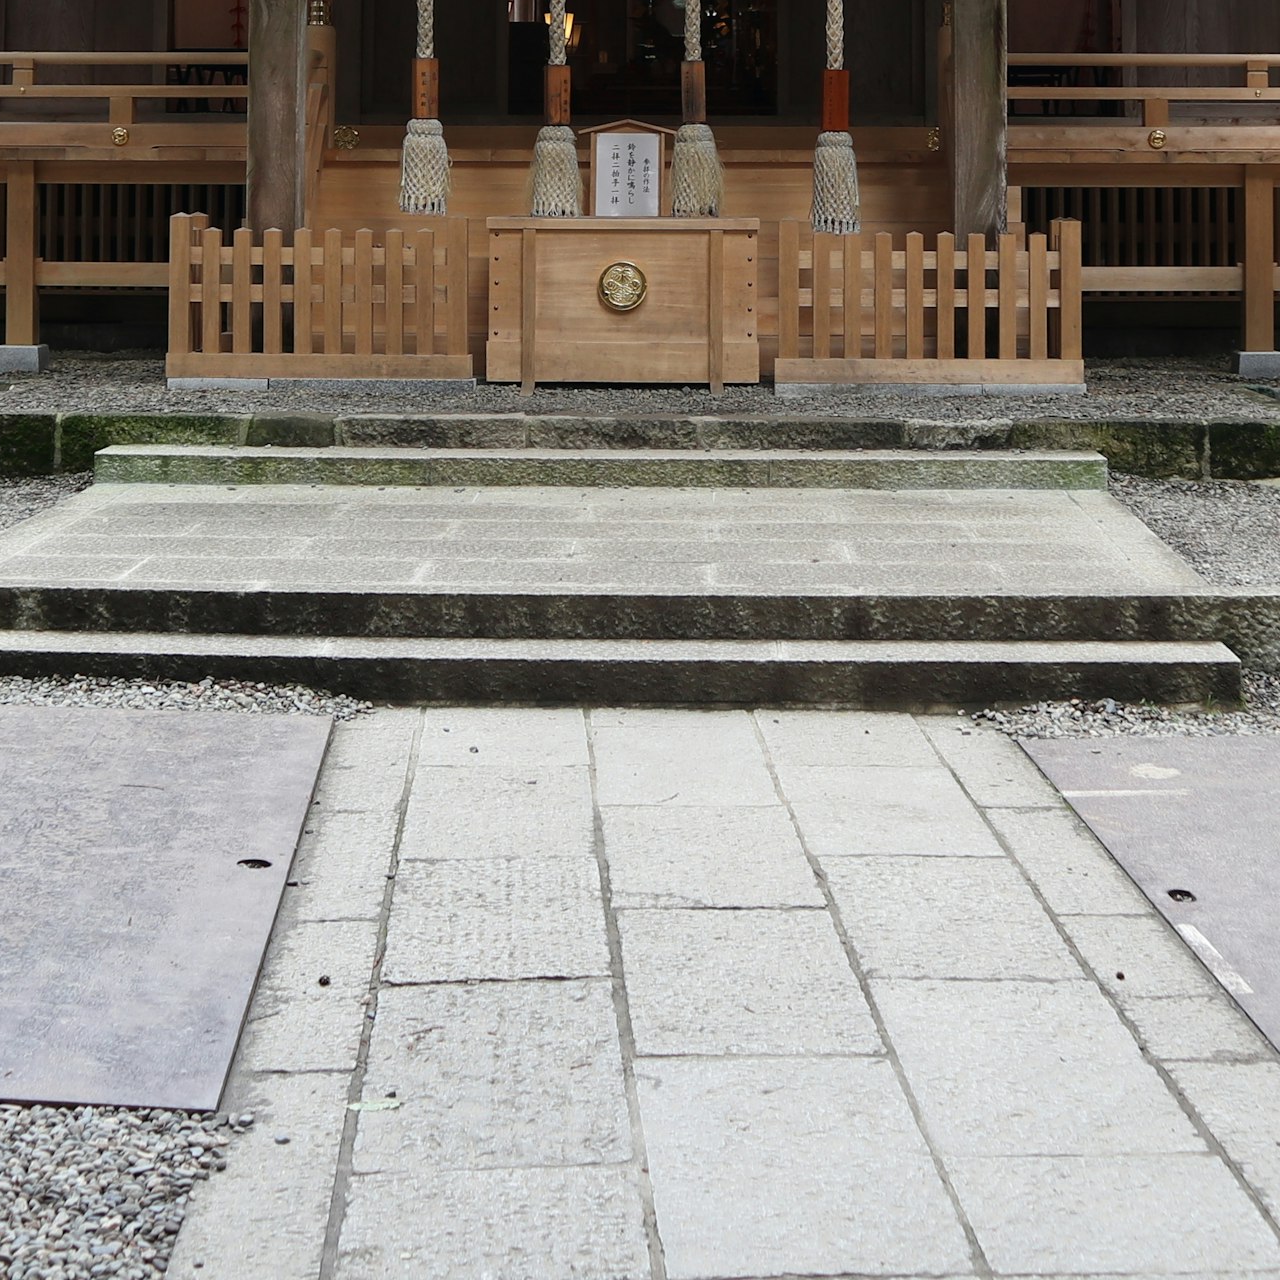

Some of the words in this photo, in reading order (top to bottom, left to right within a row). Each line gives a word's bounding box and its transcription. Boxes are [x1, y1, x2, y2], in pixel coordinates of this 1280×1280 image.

[611, 144, 620, 204] 二拝二拍手一拝
[627, 143, 636, 204] 鈴を静かに鳴らし
[643, 158, 651, 193] 参拝の作法
